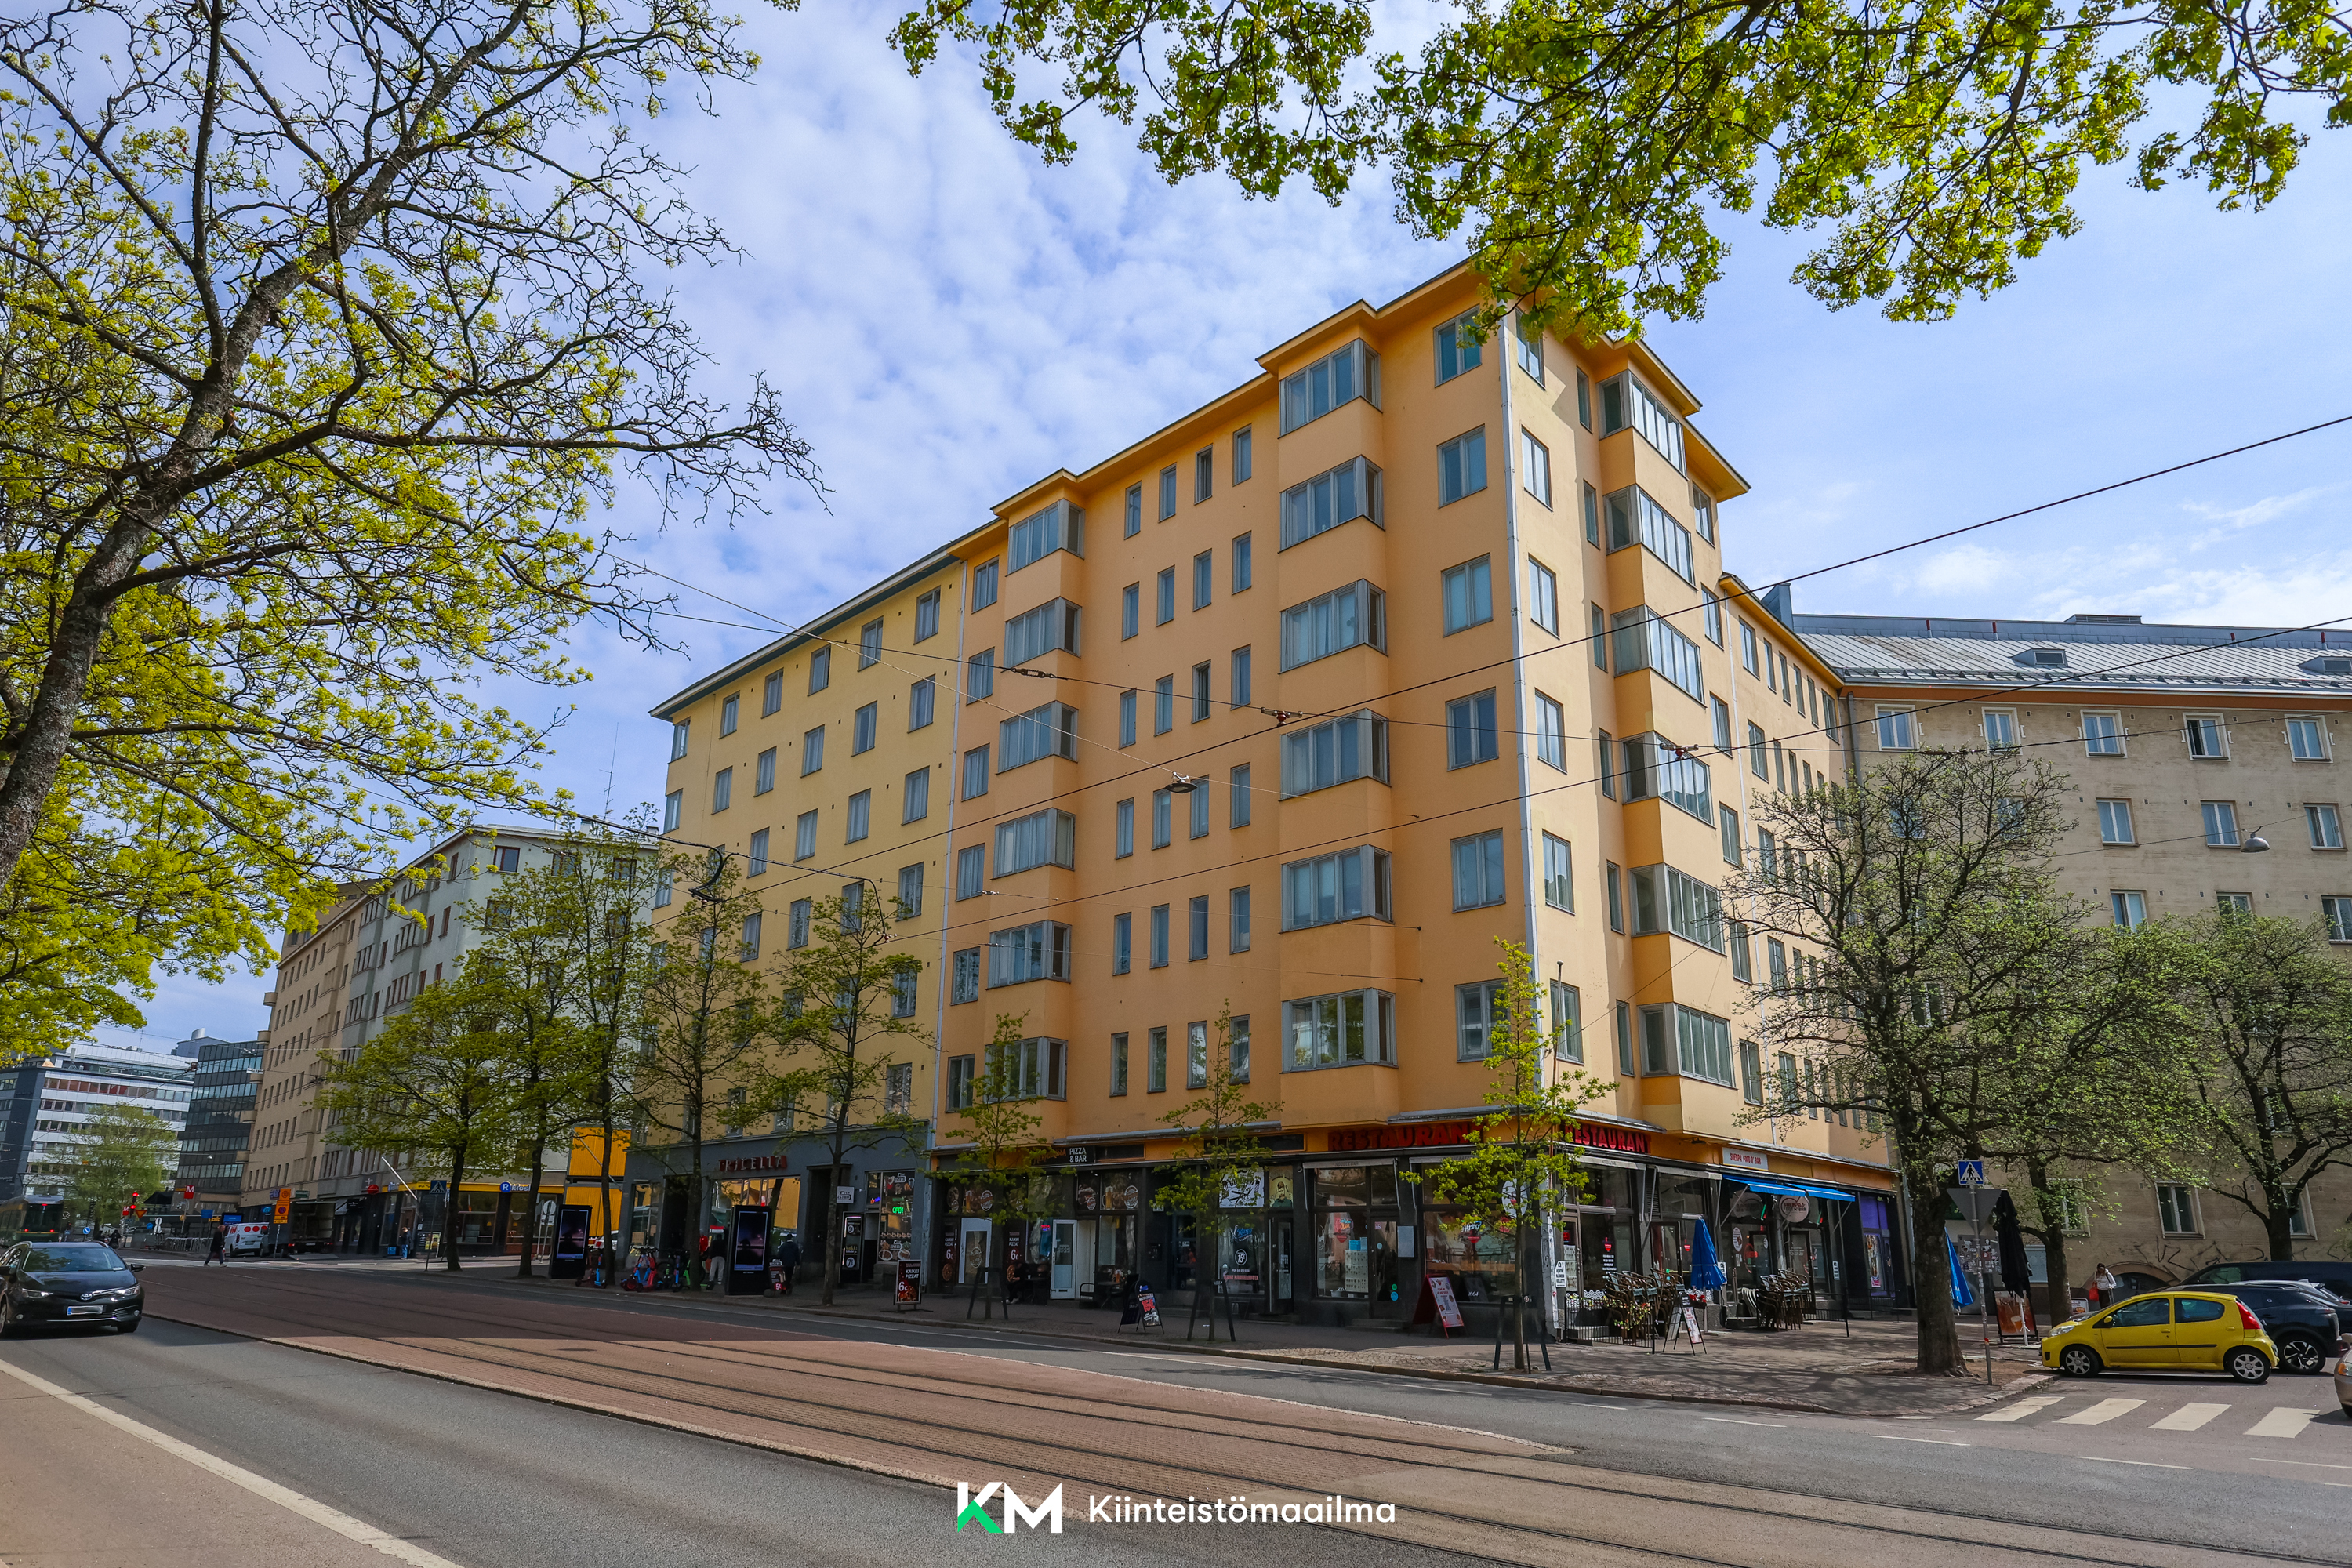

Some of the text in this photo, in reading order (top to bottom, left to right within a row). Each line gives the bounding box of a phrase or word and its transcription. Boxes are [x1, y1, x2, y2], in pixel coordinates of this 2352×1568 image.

[1565, 1123, 1651, 1154] RESTAURANT
[1730, 1152, 1742, 1162] SHERPA
[1142, 1299, 1155, 1312] 15€
